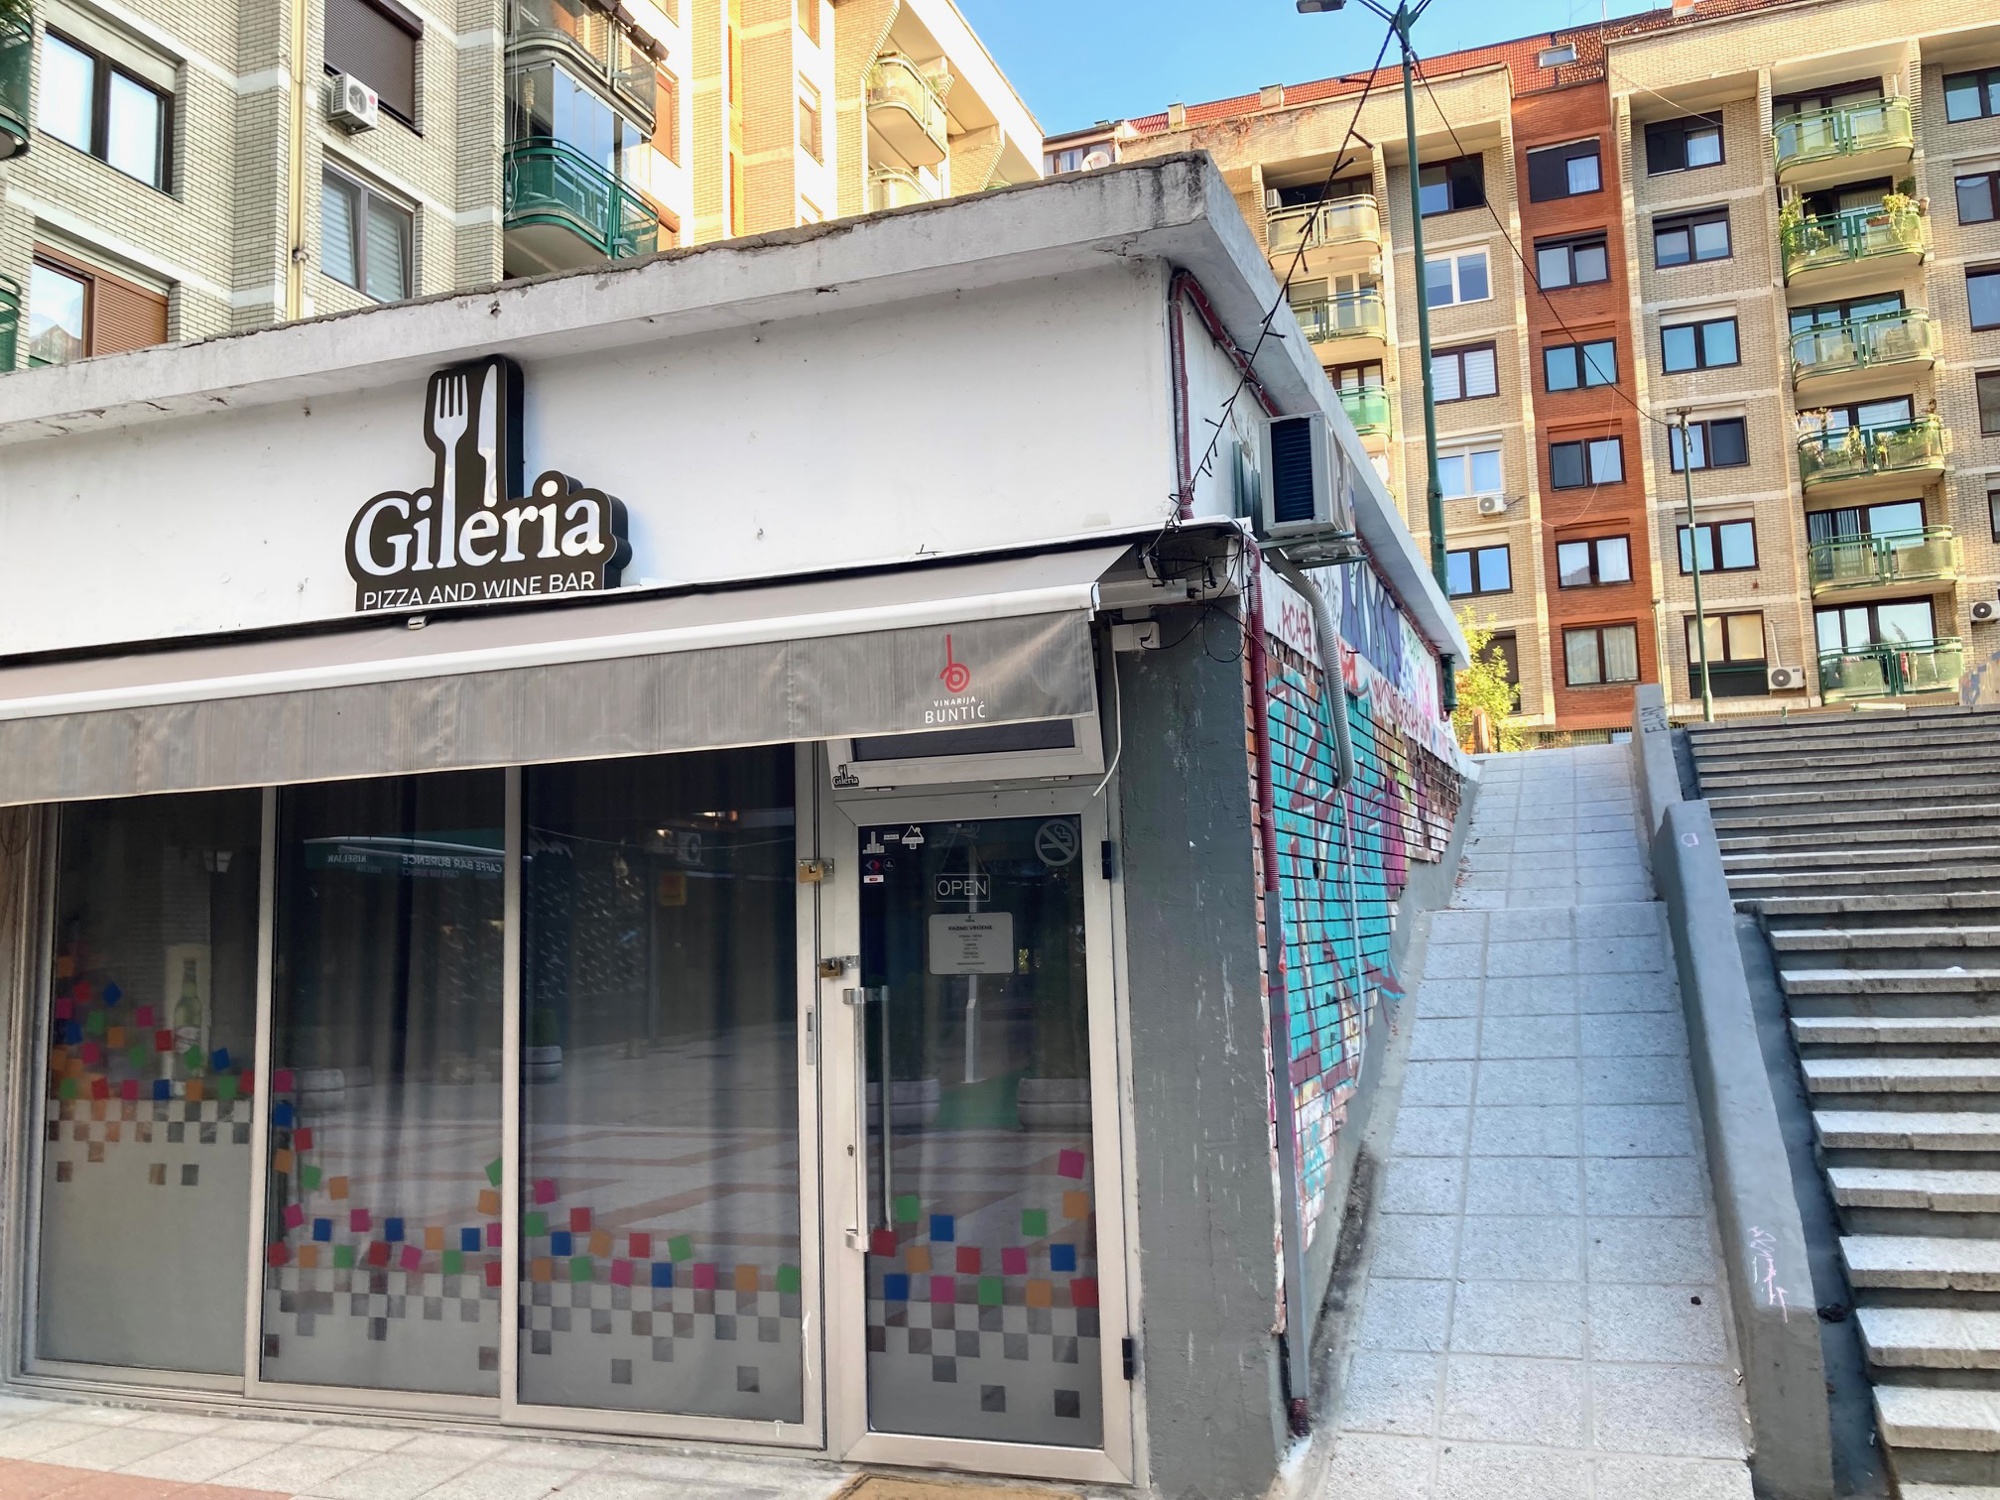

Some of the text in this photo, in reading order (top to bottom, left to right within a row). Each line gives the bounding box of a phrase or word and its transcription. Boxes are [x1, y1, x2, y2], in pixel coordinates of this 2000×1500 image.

[354, 425, 605, 577] Gileria
[363, 570, 596, 610] PIZZA AND WINE BAR
[925, 701, 986, 724] BUNTIĆ
[933, 695, 976, 708] VINARIJA
[937, 879, 988, 896] OPEN
